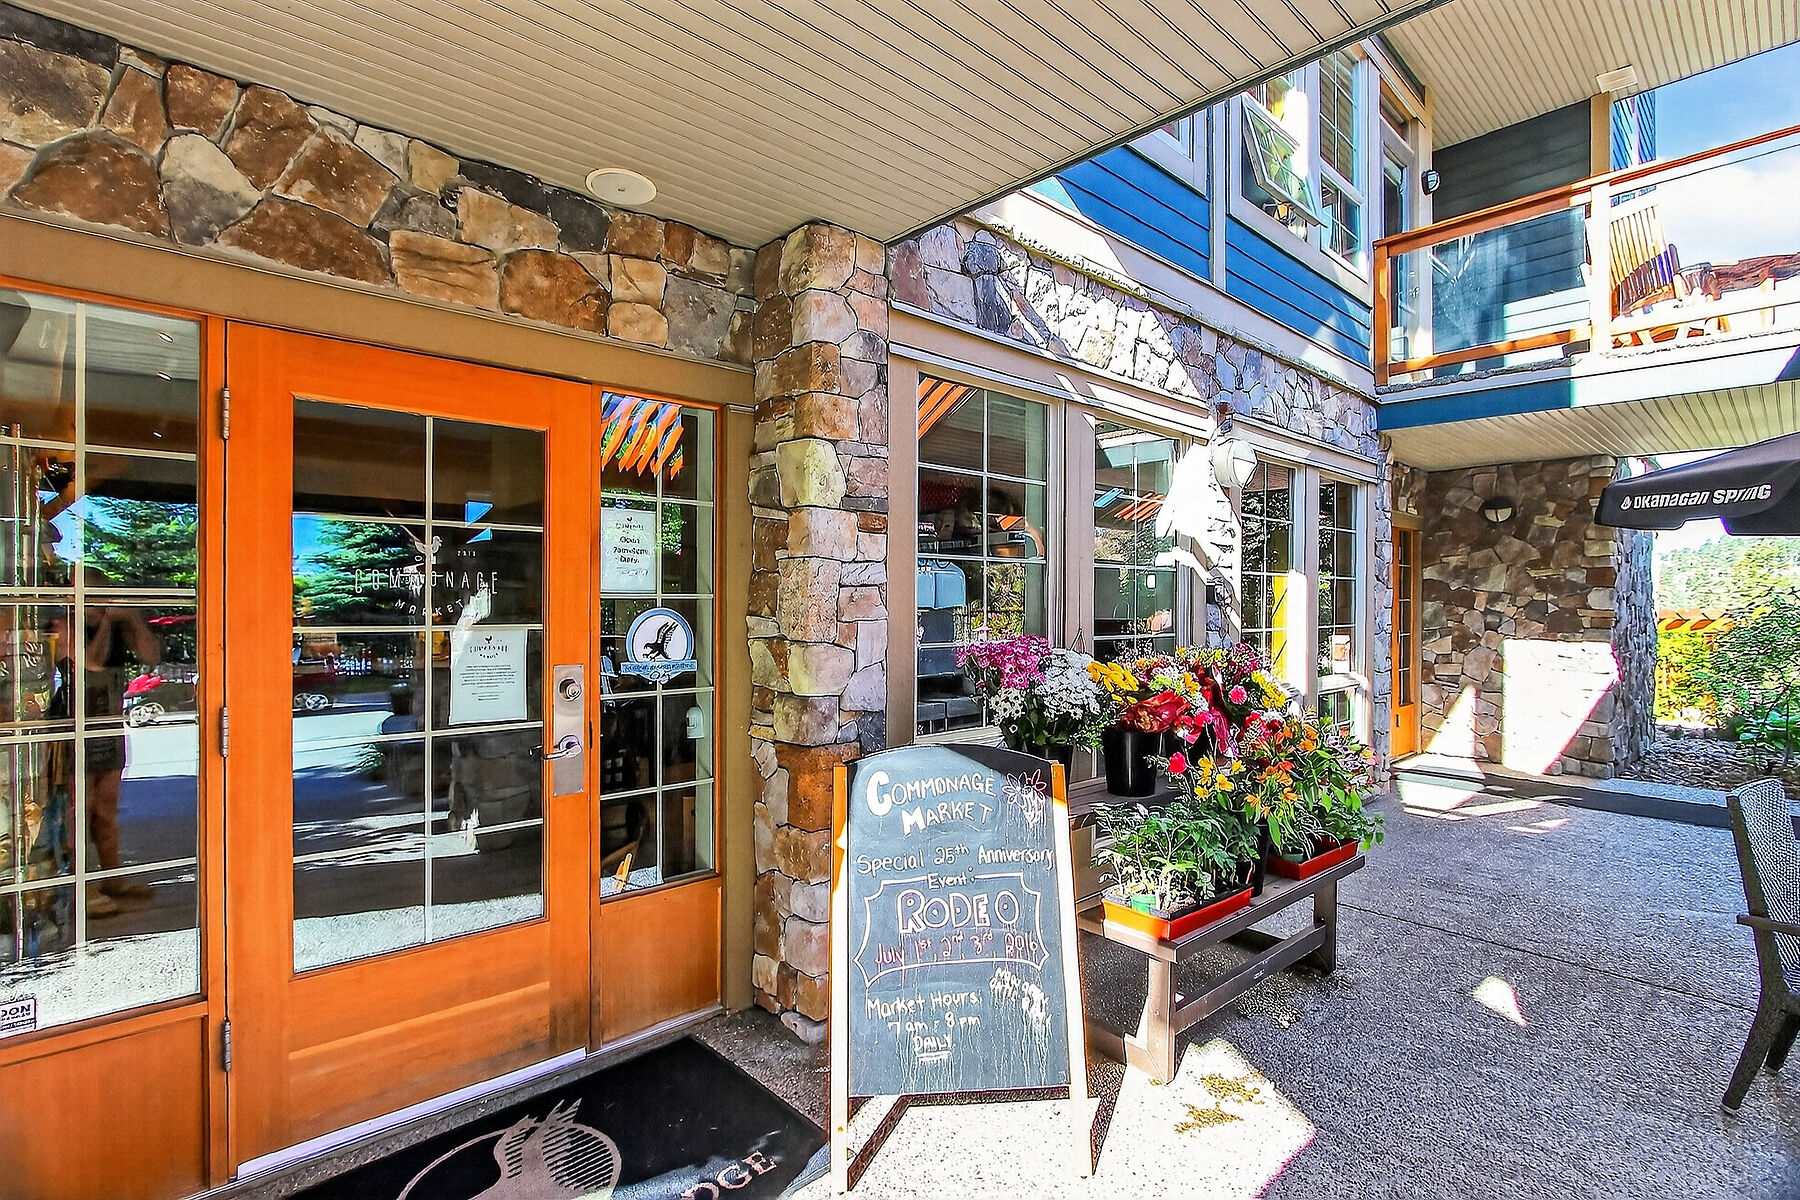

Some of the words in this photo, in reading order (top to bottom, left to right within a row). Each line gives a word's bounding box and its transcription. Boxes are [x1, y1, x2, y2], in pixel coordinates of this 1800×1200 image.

[901, 799, 994, 836] MARKET
[856, 849, 925, 880] Special
[933, 843, 970, 866] 25th
[977, 844, 1055, 871] Anniversary
[897, 889, 1020, 934] RODEO
[866, 994, 927, 1020] Market
